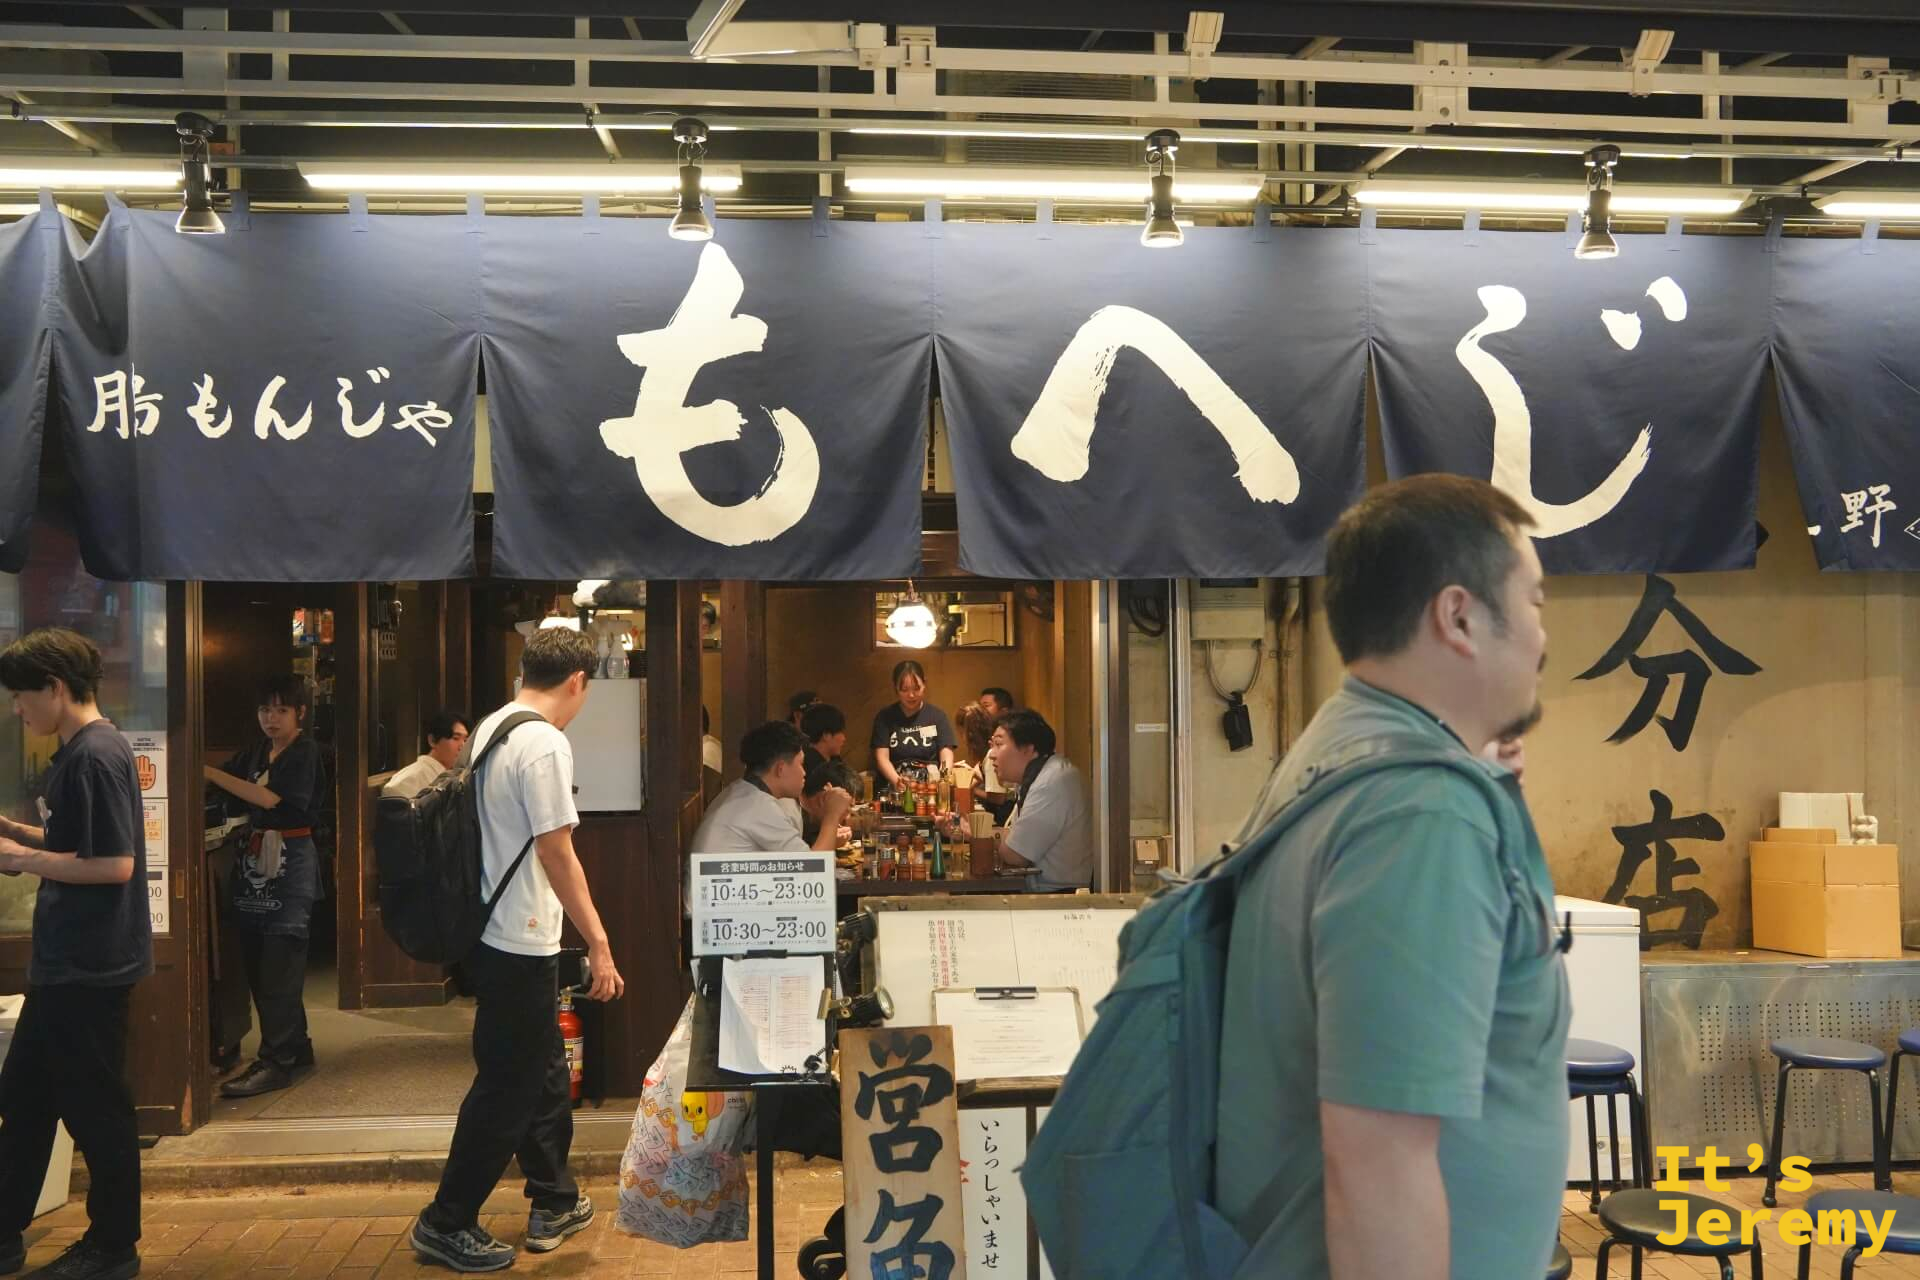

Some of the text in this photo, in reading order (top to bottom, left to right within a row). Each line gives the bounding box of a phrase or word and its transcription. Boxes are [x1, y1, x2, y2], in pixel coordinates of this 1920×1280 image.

[599, 241, 1687, 546] もへじ
[1808, 484, 1897, 549] 野
[1572, 520, 1769, 951] 分店
[720, 861, 805, 873] 営業時間のお知らせ
[980, 1119, 1001, 1269] いらっしゃいませ
